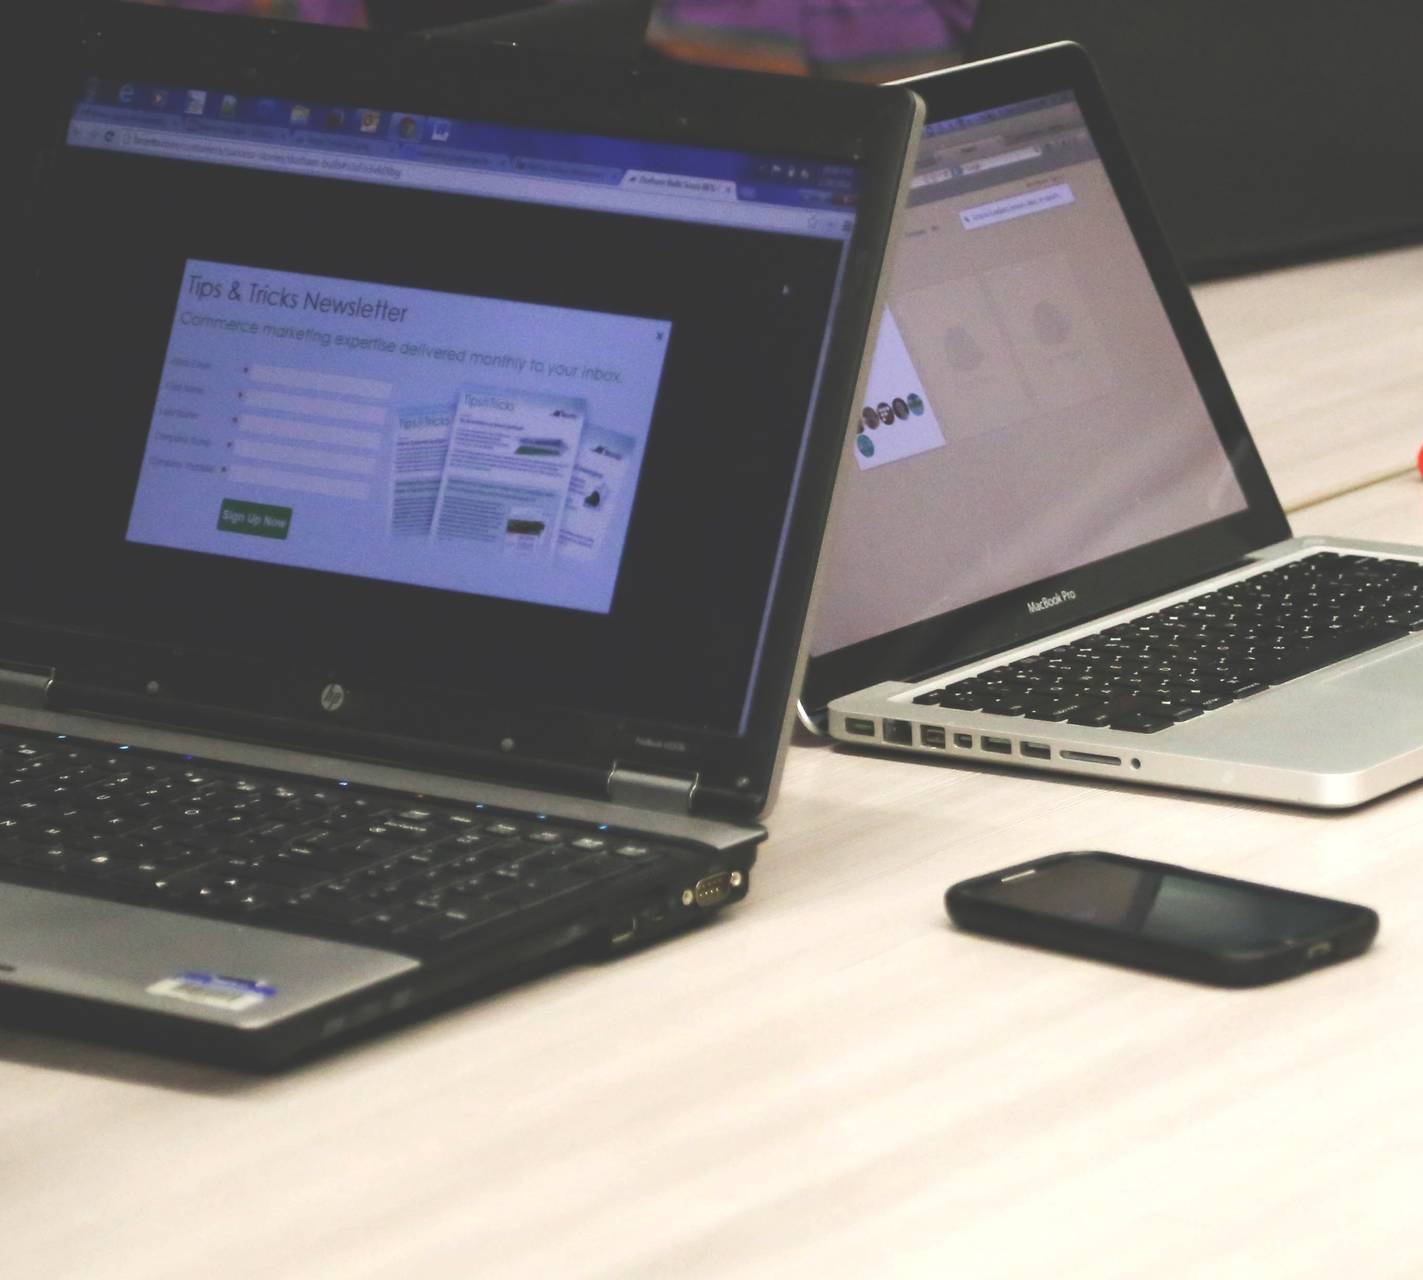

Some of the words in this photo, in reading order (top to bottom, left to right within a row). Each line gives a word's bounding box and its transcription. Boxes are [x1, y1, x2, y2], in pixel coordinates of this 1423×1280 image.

[188, 274, 222, 299] Tips
[228, 280, 242, 301] &
[249, 282, 299, 309] Tricks
[304, 291, 409, 323] Newsletter
[180, 310, 260, 335] Commerce
[263, 323, 331, 346] marketing
[334, 333, 396, 354] expertise
[400, 340, 466, 363] delivered
[469, 351, 527, 374] monthly
[529, 357, 545, 372] to
[548, 362, 578, 379] your
[582, 365, 624, 384] inbox.
[222, 510, 246, 525] Sign
[247, 513, 262, 528] Up
[263, 515, 288, 529] Now
[1026, 593, 1062, 613] MacBook
[1061, 590, 1076, 601] Pro
